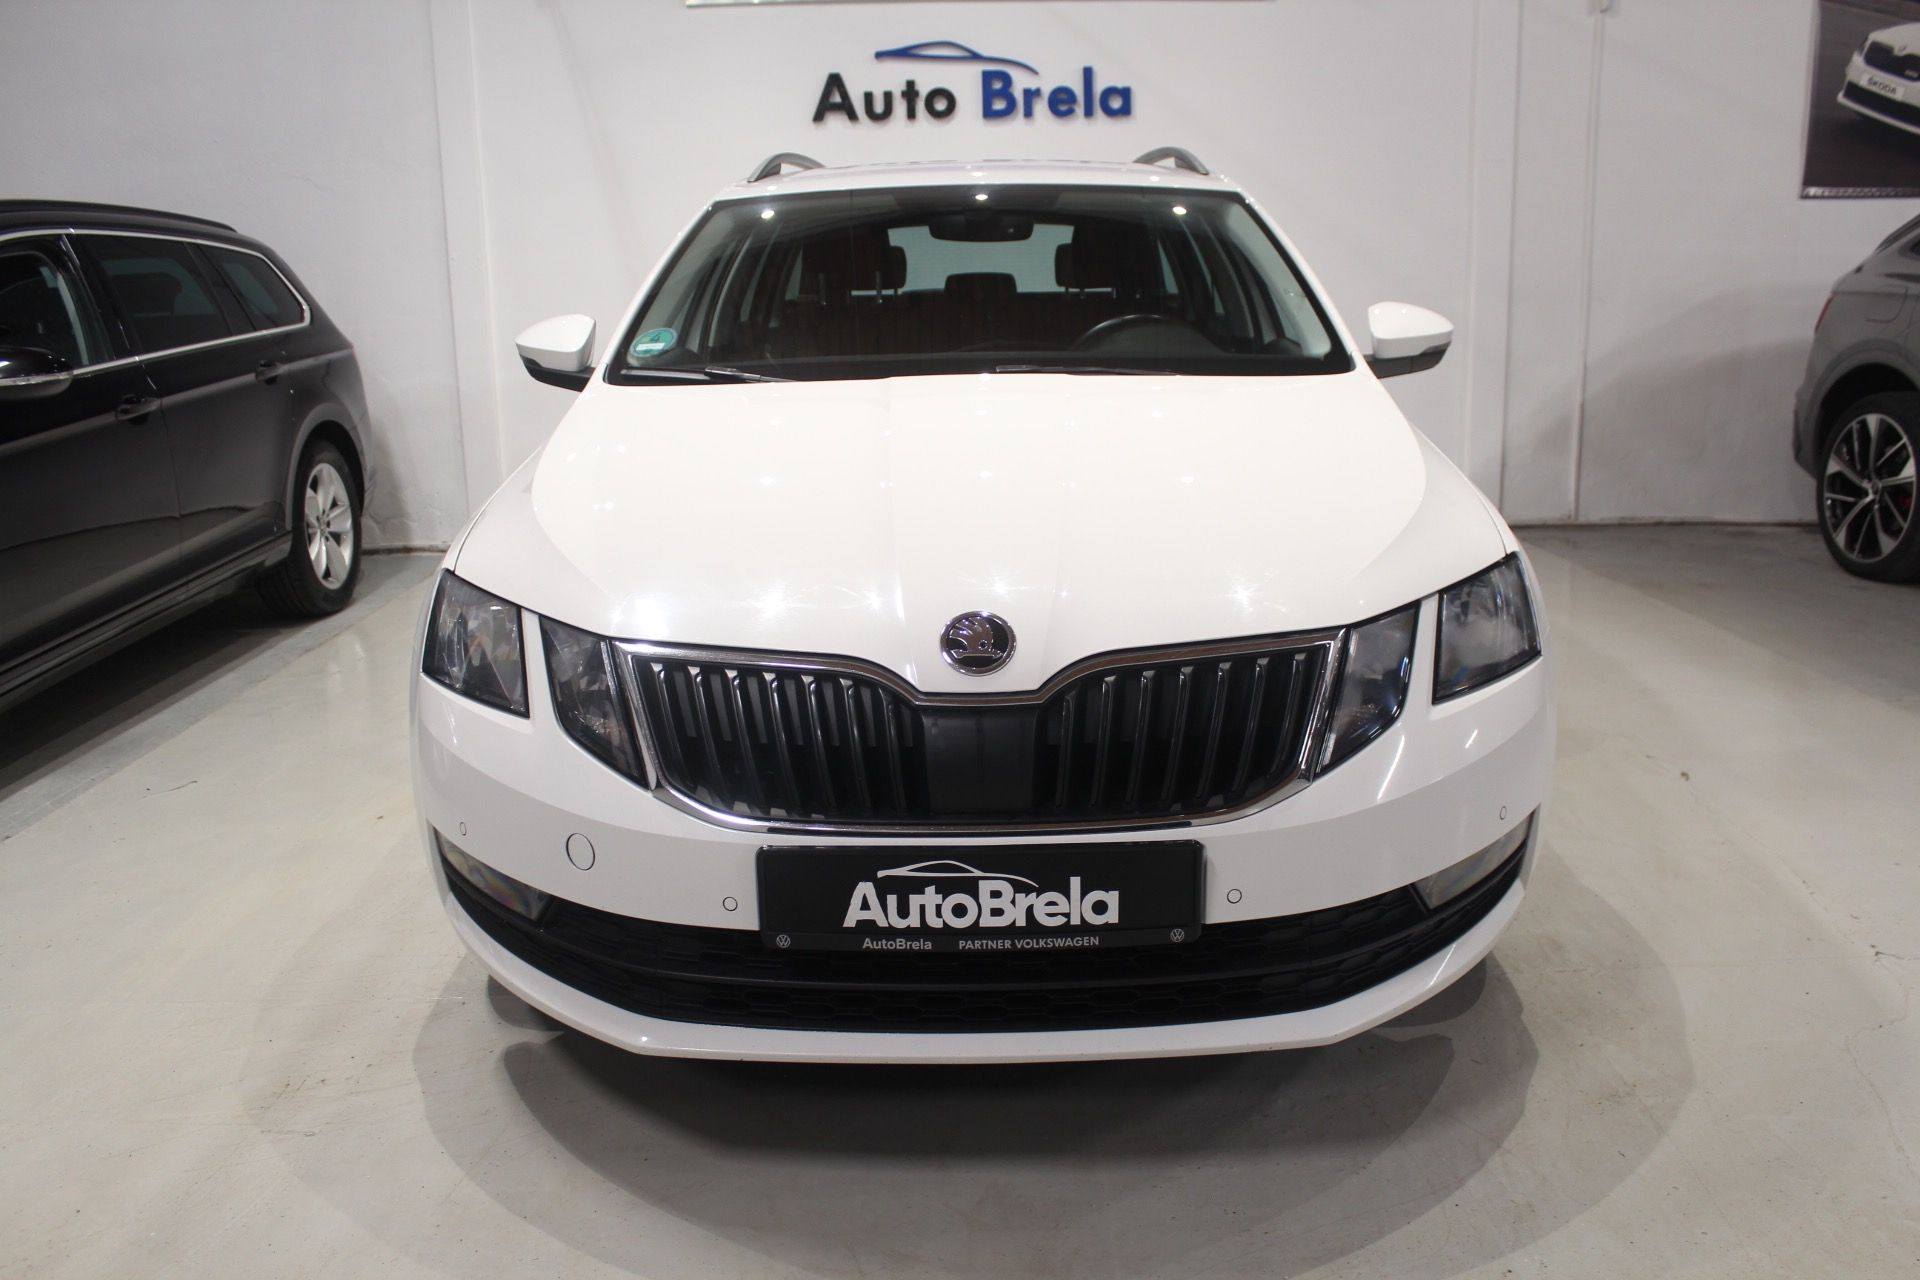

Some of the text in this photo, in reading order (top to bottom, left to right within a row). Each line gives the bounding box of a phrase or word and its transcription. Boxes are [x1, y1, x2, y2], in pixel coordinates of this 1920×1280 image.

[812, 66, 1132, 123] Auto Brela
[842, 876, 1119, 928] AutoBrela
[862, 937, 932, 950] AutoBrela
[958, 936, 1100, 950] PARTNER VOLKSWAGEN
